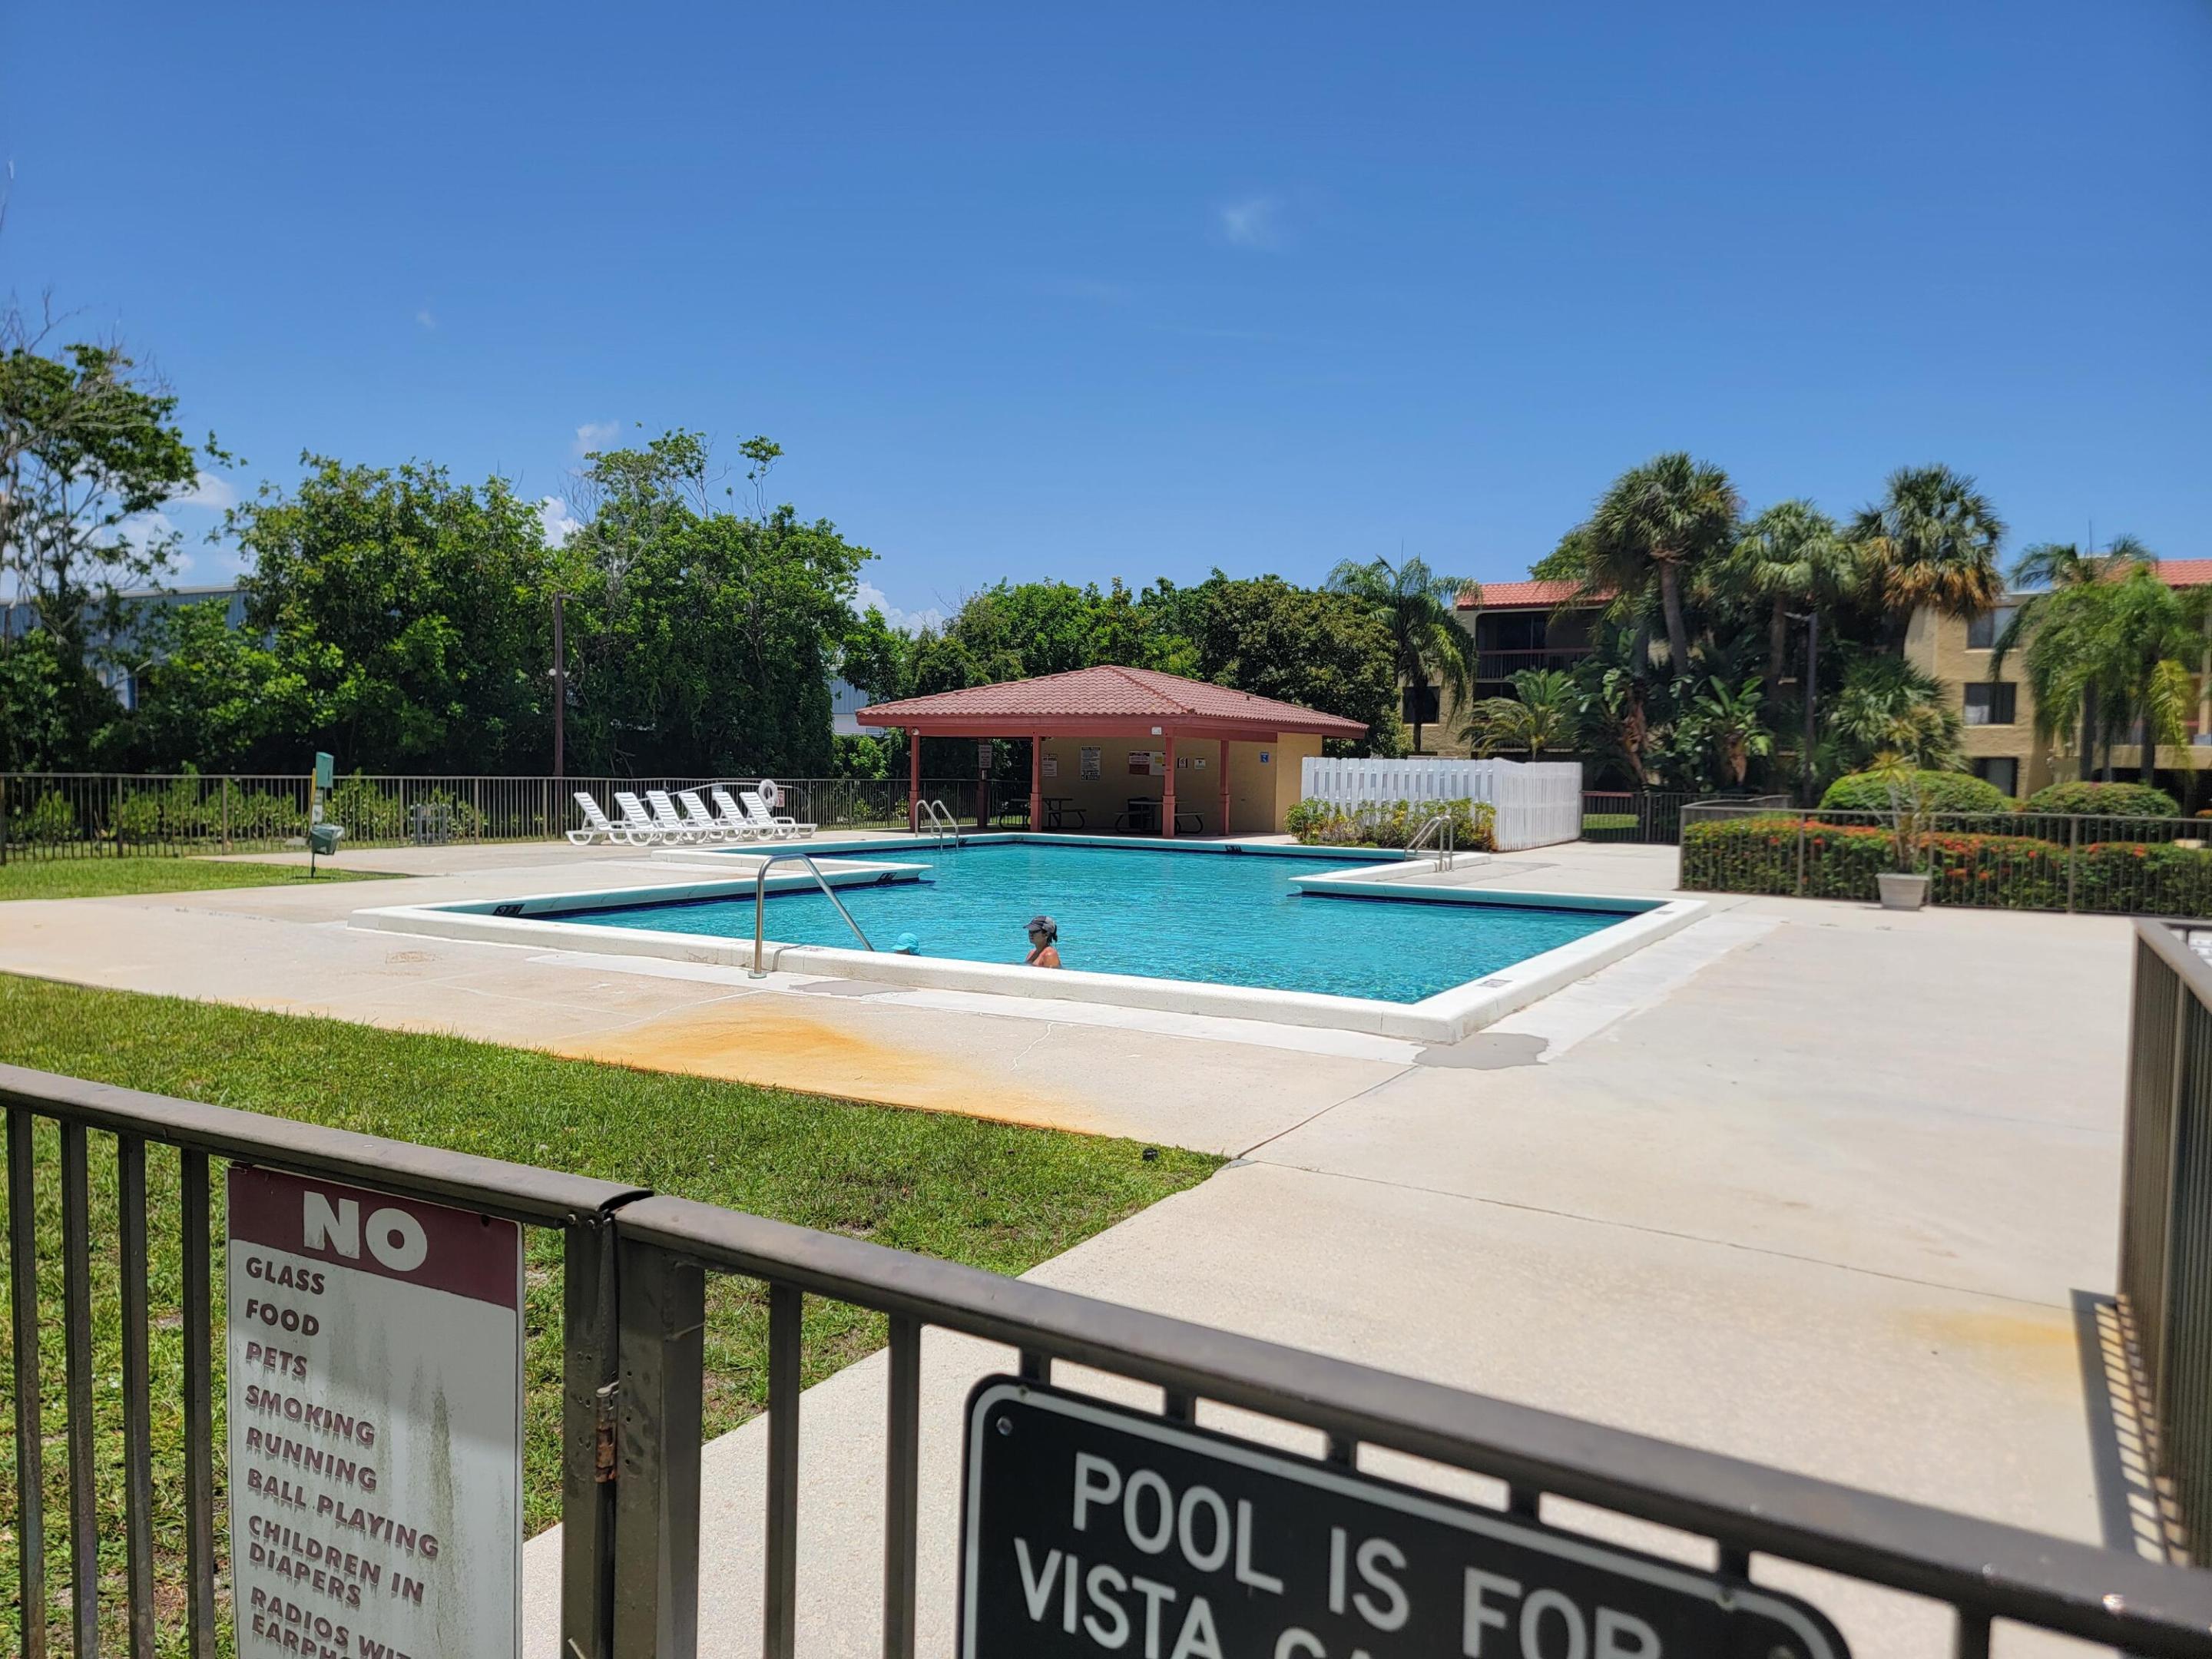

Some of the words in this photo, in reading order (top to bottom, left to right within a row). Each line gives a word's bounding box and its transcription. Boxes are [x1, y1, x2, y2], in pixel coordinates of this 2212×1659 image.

[304, 1190, 428, 1271] NO
[246, 1257, 325, 1295] GLASS
[246, 1299, 319, 1336] FOOD
[246, 1342, 306, 1377] PETS
[245, 1385, 375, 1445] SMOKING
[246, 1427, 376, 1490] RUNNING
[247, 1468, 306, 1508] BALL
[317, 1495, 439, 1558] PLAYING
[1073, 1452, 1283, 1594] POOL
[1329, 1527, 1409, 1632] IS
[249, 1515, 381, 1586] CHILDREN
[391, 1573, 424, 1604] IN
[250, 1542, 361, 1607] DIAPERS
[250, 1586, 349, 1647] RADIOS
[1014, 1538, 1224, 1659] VISTA
[251, 1614, 352, 1659] EARPH
